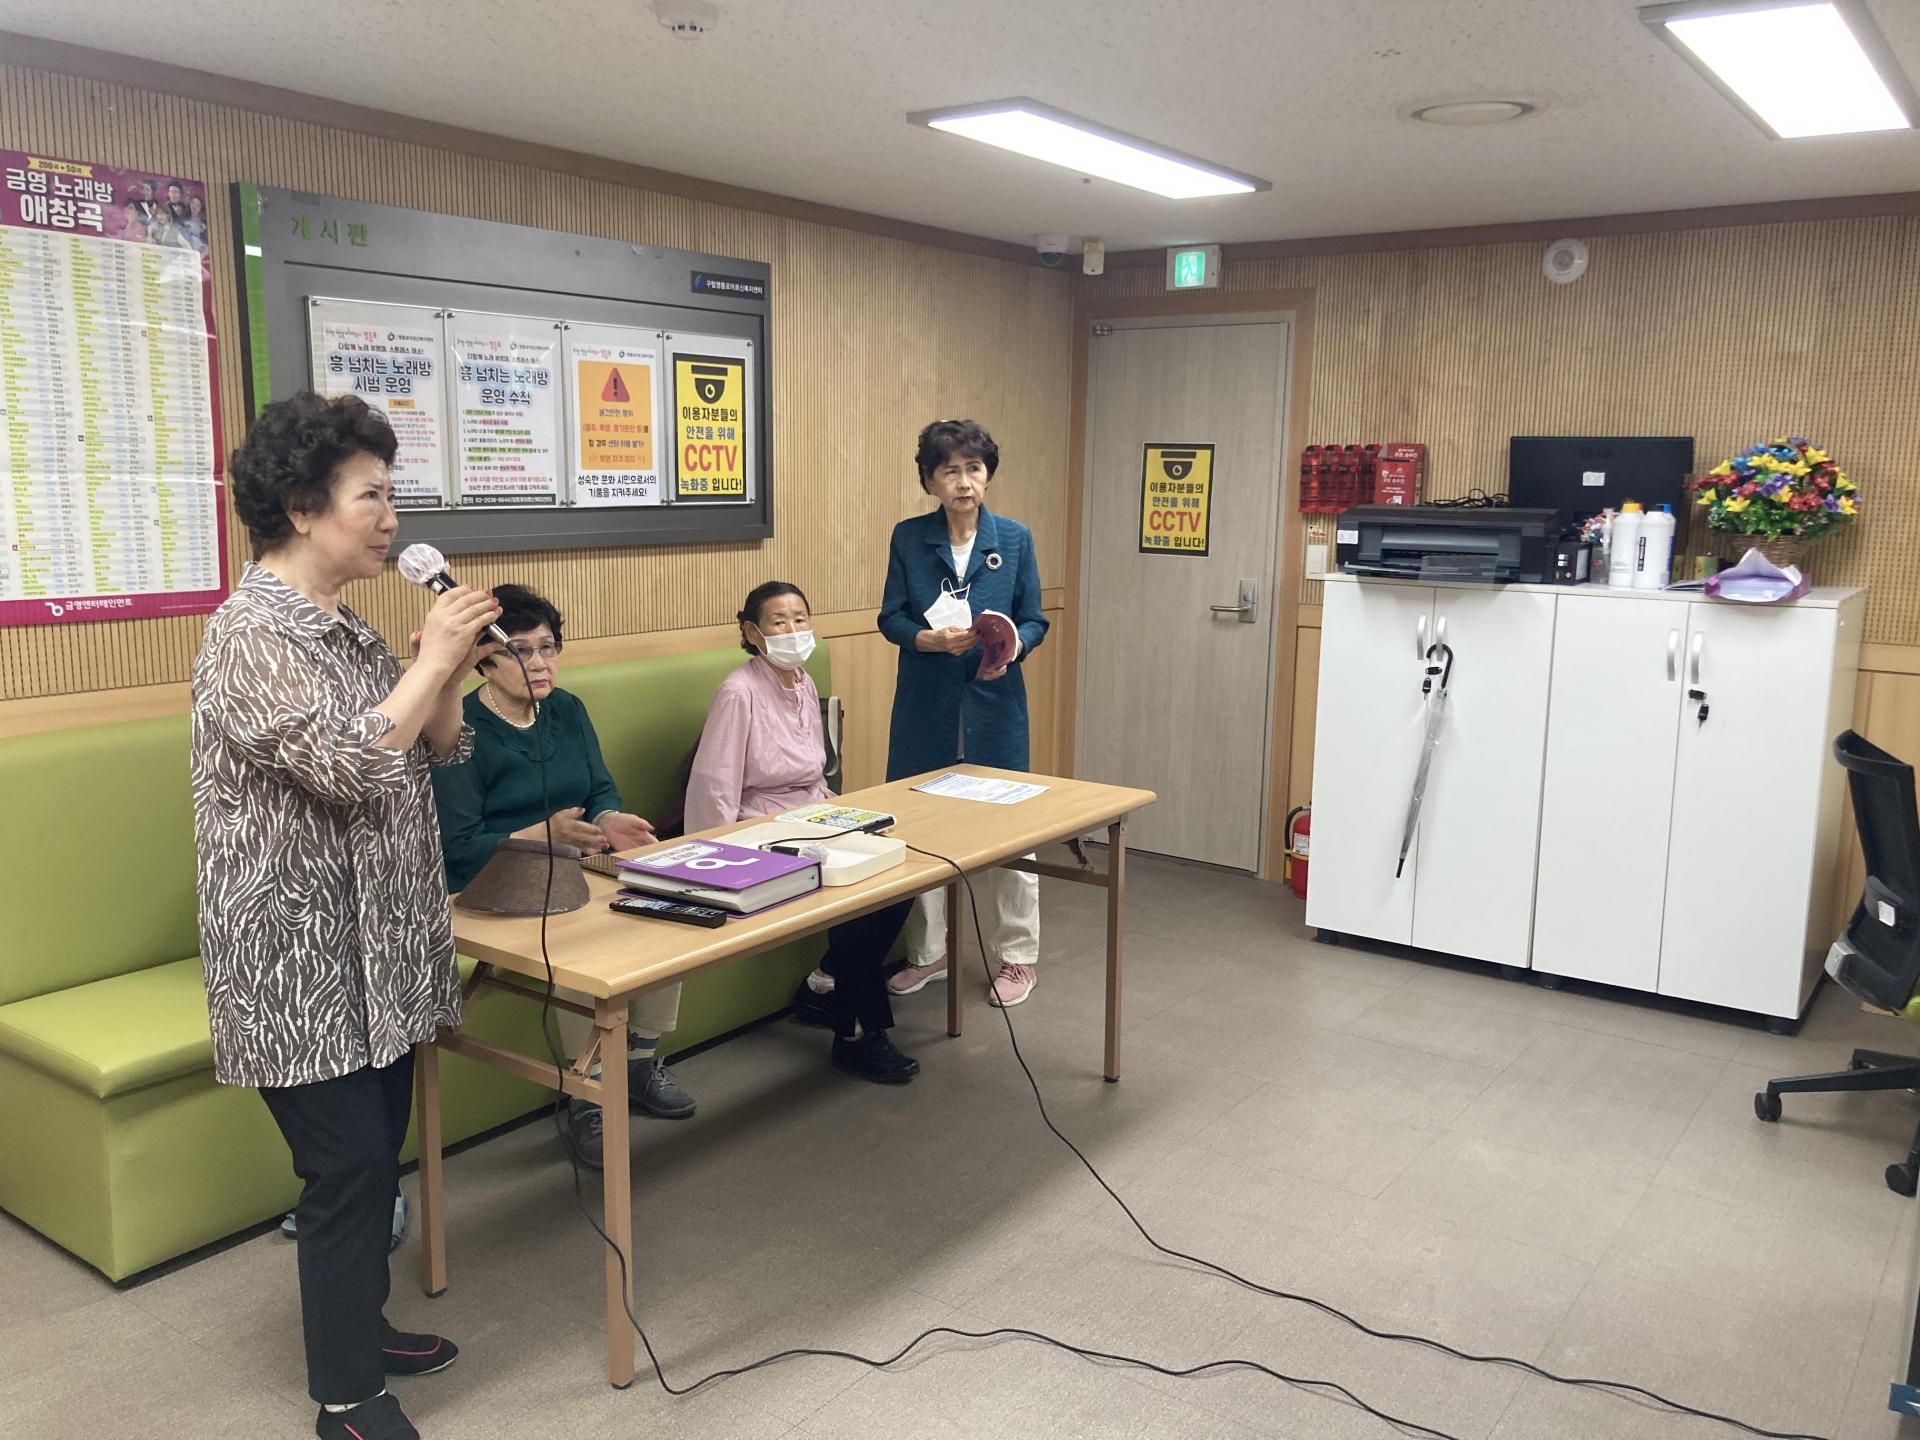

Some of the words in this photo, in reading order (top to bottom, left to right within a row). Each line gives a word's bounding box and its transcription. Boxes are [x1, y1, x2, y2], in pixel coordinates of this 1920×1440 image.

[6, 167, 47, 194] 금영
[54, 175, 113, 203] 노래방
[20, 194, 103, 232] 애창곡
[330, 355, 343, 372] 흥
[349, 356, 388, 375] 넘치는
[392, 359, 431, 377] 노래방
[476, 366, 511, 383] 넘치는
[514, 369, 549, 386] 노래방
[355, 376, 380, 392] 시범
[385, 377, 411, 394] 운영
[482, 388, 505, 405] 운영
[509, 390, 531, 405] 수칙
[682, 406, 738, 422] 이용자분들의
[686, 425, 714, 440] 안전을
[717, 427, 735, 441] 위해
[684, 444, 738, 472] CCTV
[578, 475, 599, 485] 성숙한
[601, 475, 615, 485] 문화
[617, 475, 657, 485] 시민으로서의
[680, 477, 709, 491] 녹화중
[712, 478, 742, 491] 입니다!
[1150, 482, 1204, 494] 이용자분들의
[1152, 496, 1178, 508] 안전을
[1182, 497, 1200, 508] 위해
[1149, 510, 1202, 532] CCTV
[1144, 535, 1170, 546] 녹화중
[1174, 536, 1205, 547] 입니다!
